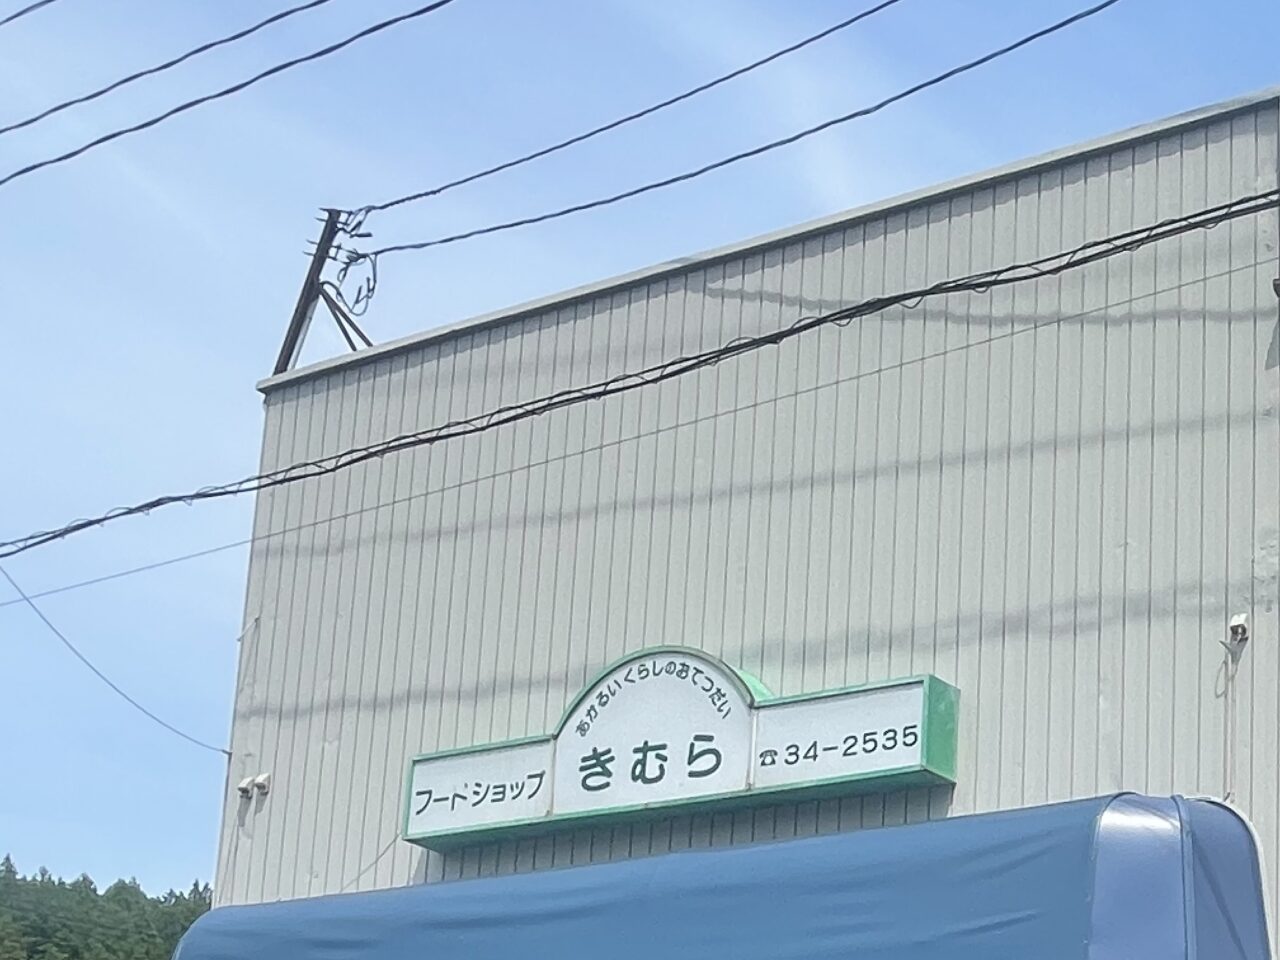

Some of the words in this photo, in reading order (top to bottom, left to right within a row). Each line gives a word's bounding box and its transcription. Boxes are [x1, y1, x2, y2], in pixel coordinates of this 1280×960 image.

[575, 661, 732, 737] あかるいくらしのおてつだい
[579, 734, 722, 792] きむら
[784, 724, 918, 765] 34-2535
[415, 769, 546, 816] フードショップ
